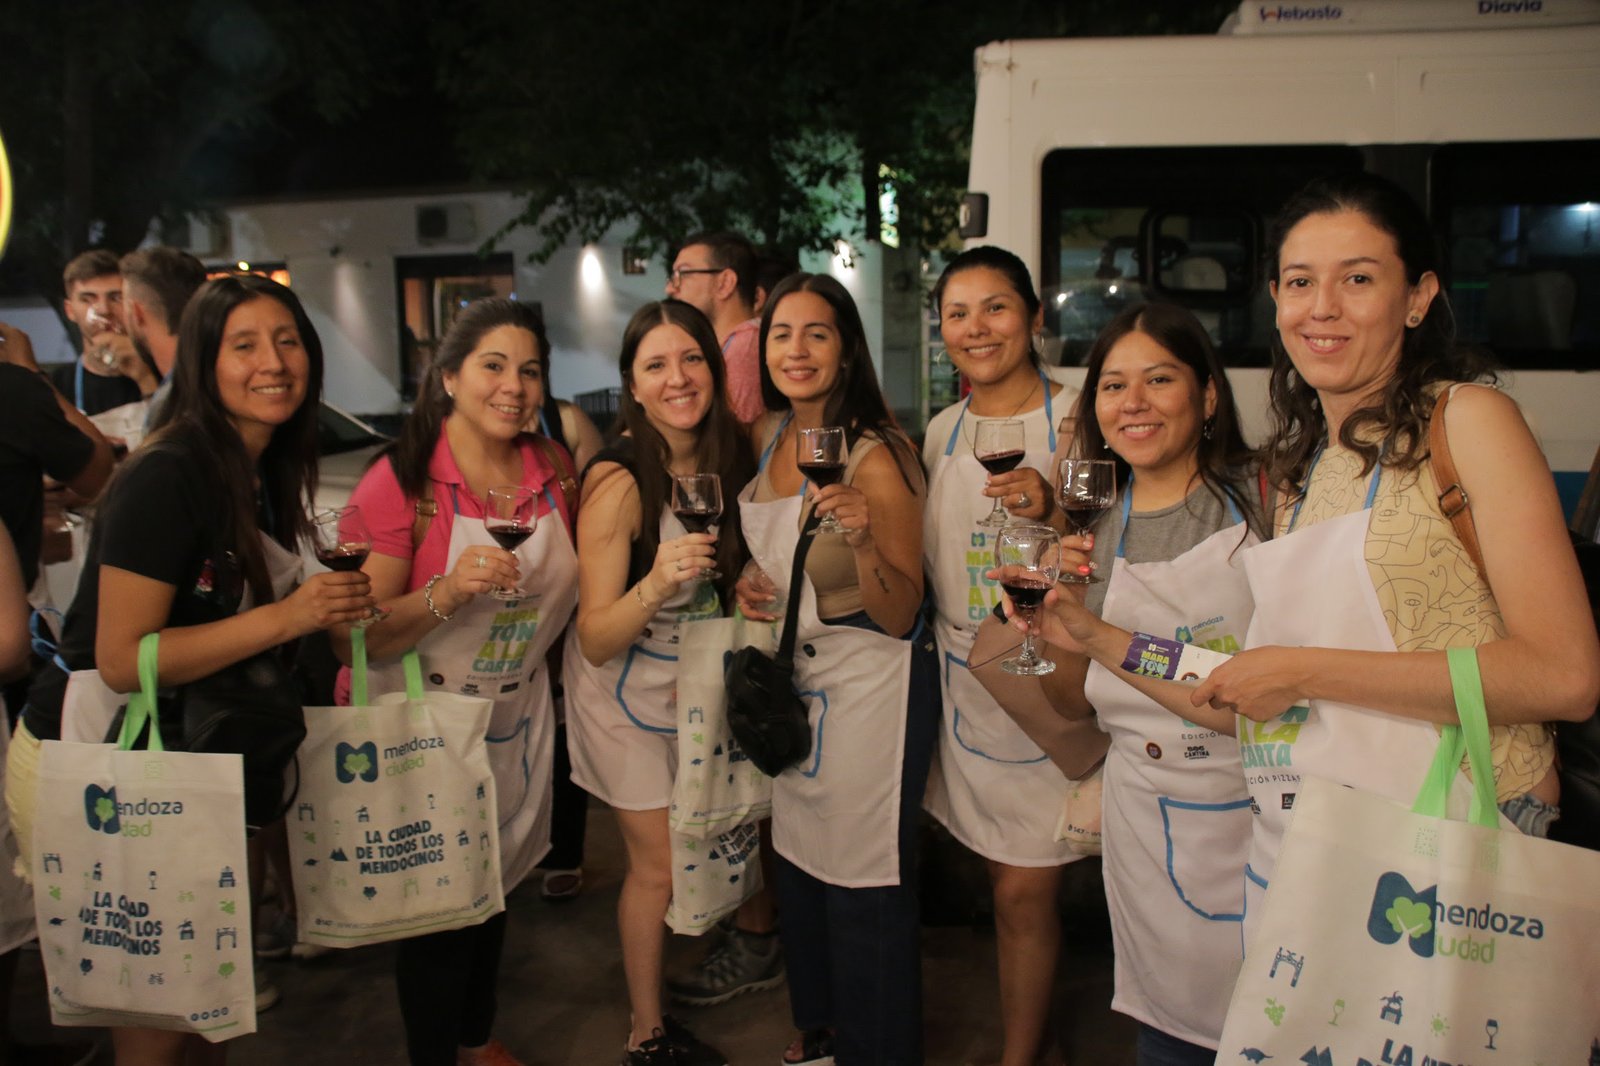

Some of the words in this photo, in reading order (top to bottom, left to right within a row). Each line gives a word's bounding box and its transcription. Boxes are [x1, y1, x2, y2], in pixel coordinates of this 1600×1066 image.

[1479, 0, 1542, 14] Diavia
[1141, 651, 1170, 665] MARA
[384, 737, 445, 760] mendoza
[1241, 744, 1293, 769] CARTA
[1247, 775, 1270, 785] ICIÓN
[117, 798, 183, 816] endoza
[365, 831, 383, 844] LA
[388, 820, 432, 842] CIUDAD
[356, 847, 373, 860] DE
[378, 839, 417, 858] TODOS
[422, 833, 444, 849] LOS
[360, 849, 445, 875] MENDOCINOS
[94, 891, 113, 908] LA
[136, 920, 162, 937] LOS
[1436, 933, 1496, 964] udad
[1381, 1038, 1413, 1066] LA
